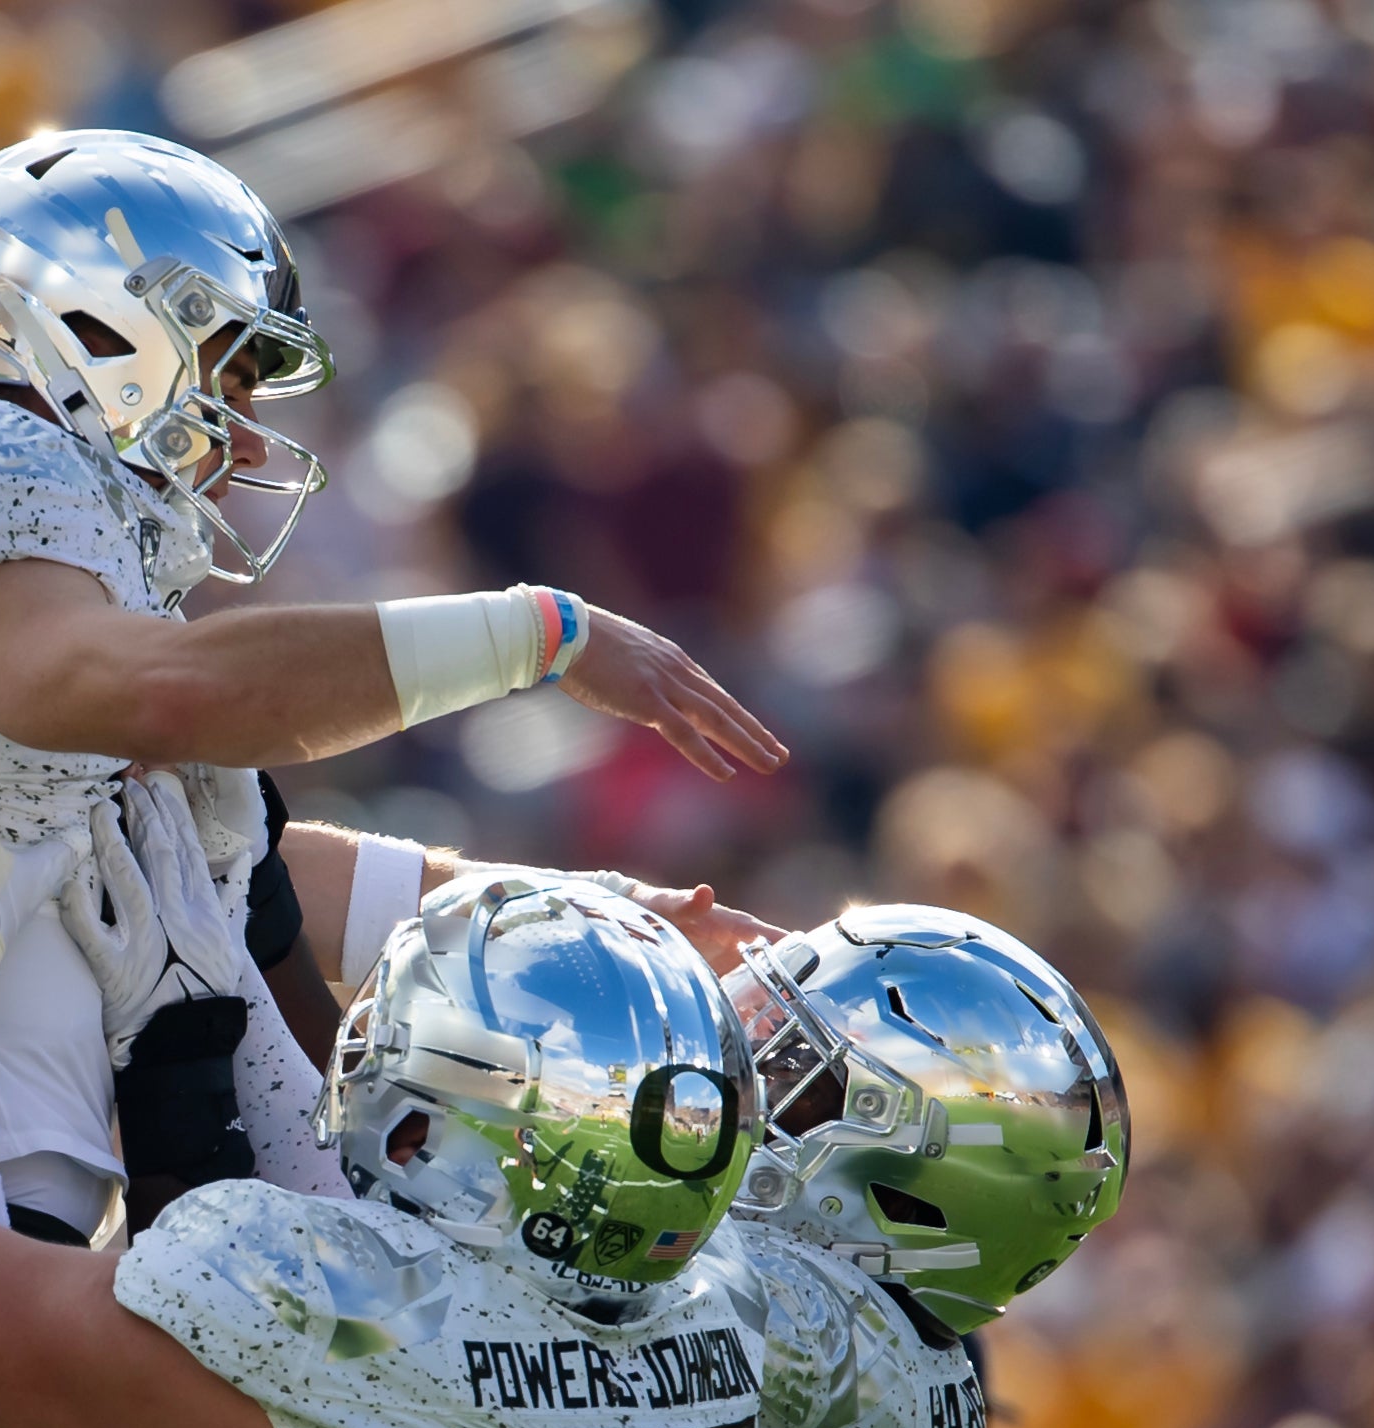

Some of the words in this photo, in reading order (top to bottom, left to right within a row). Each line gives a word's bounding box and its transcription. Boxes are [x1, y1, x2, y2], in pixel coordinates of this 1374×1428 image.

[629, 1064, 740, 1180] O
[531, 1217, 568, 1249] 64
[463, 1327, 760, 1409] POWERS-JOHNSON
